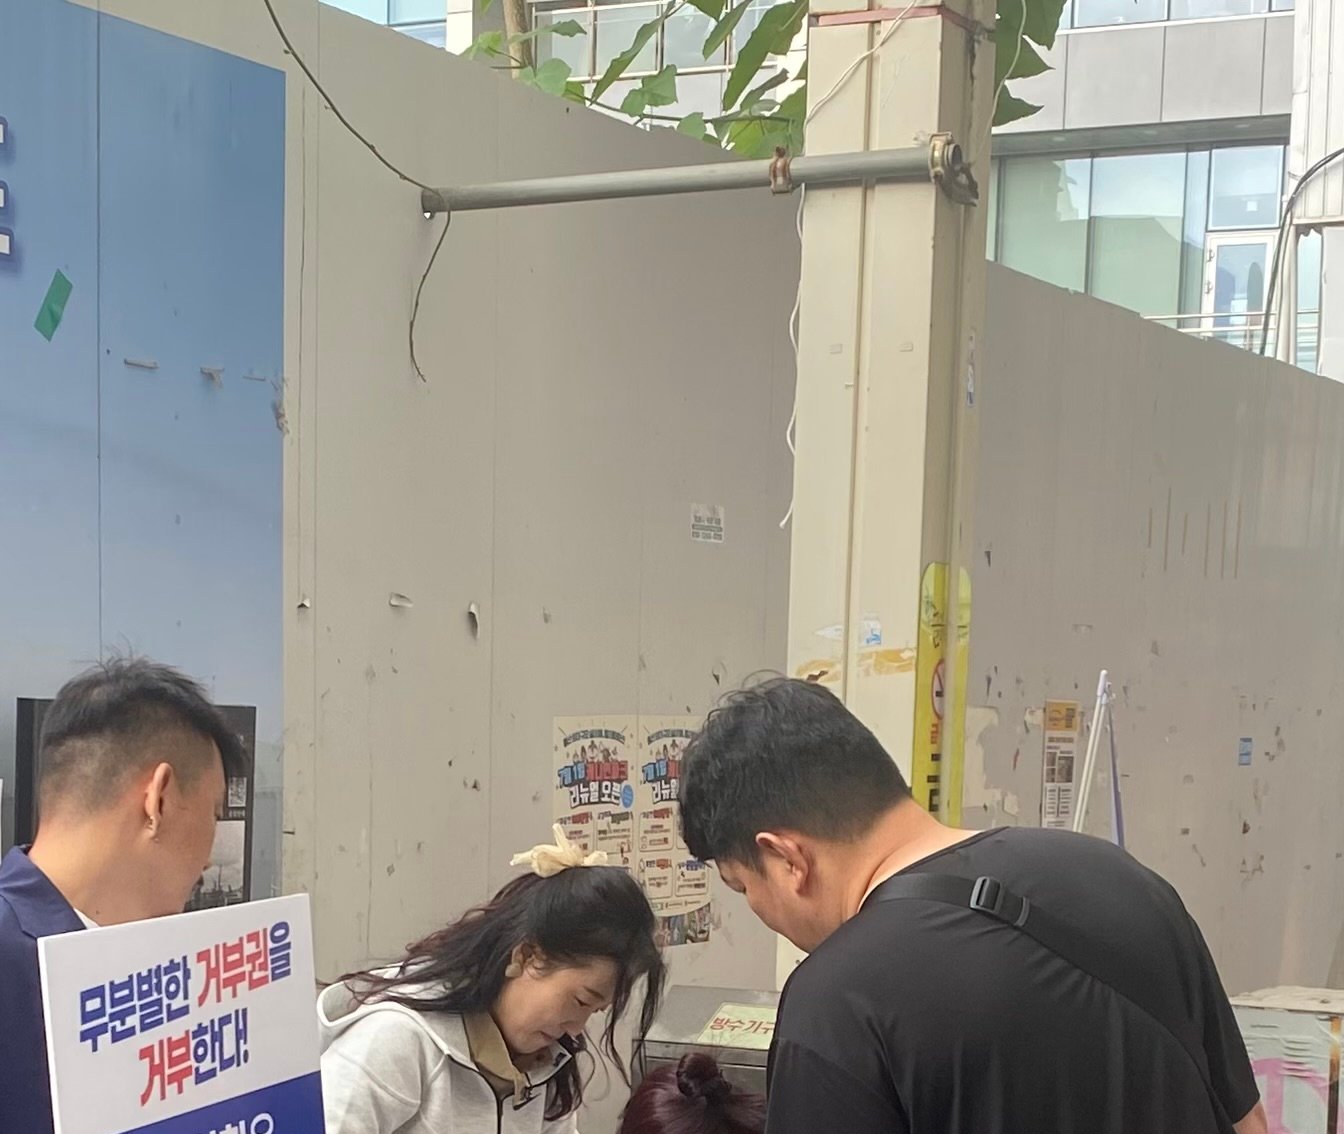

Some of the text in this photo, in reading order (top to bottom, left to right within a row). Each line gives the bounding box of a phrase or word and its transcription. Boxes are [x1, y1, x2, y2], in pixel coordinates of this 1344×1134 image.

[80, 921, 292, 1052] 무분별한 거부권을
[138, 1008, 249, 1107] 거부한다!
